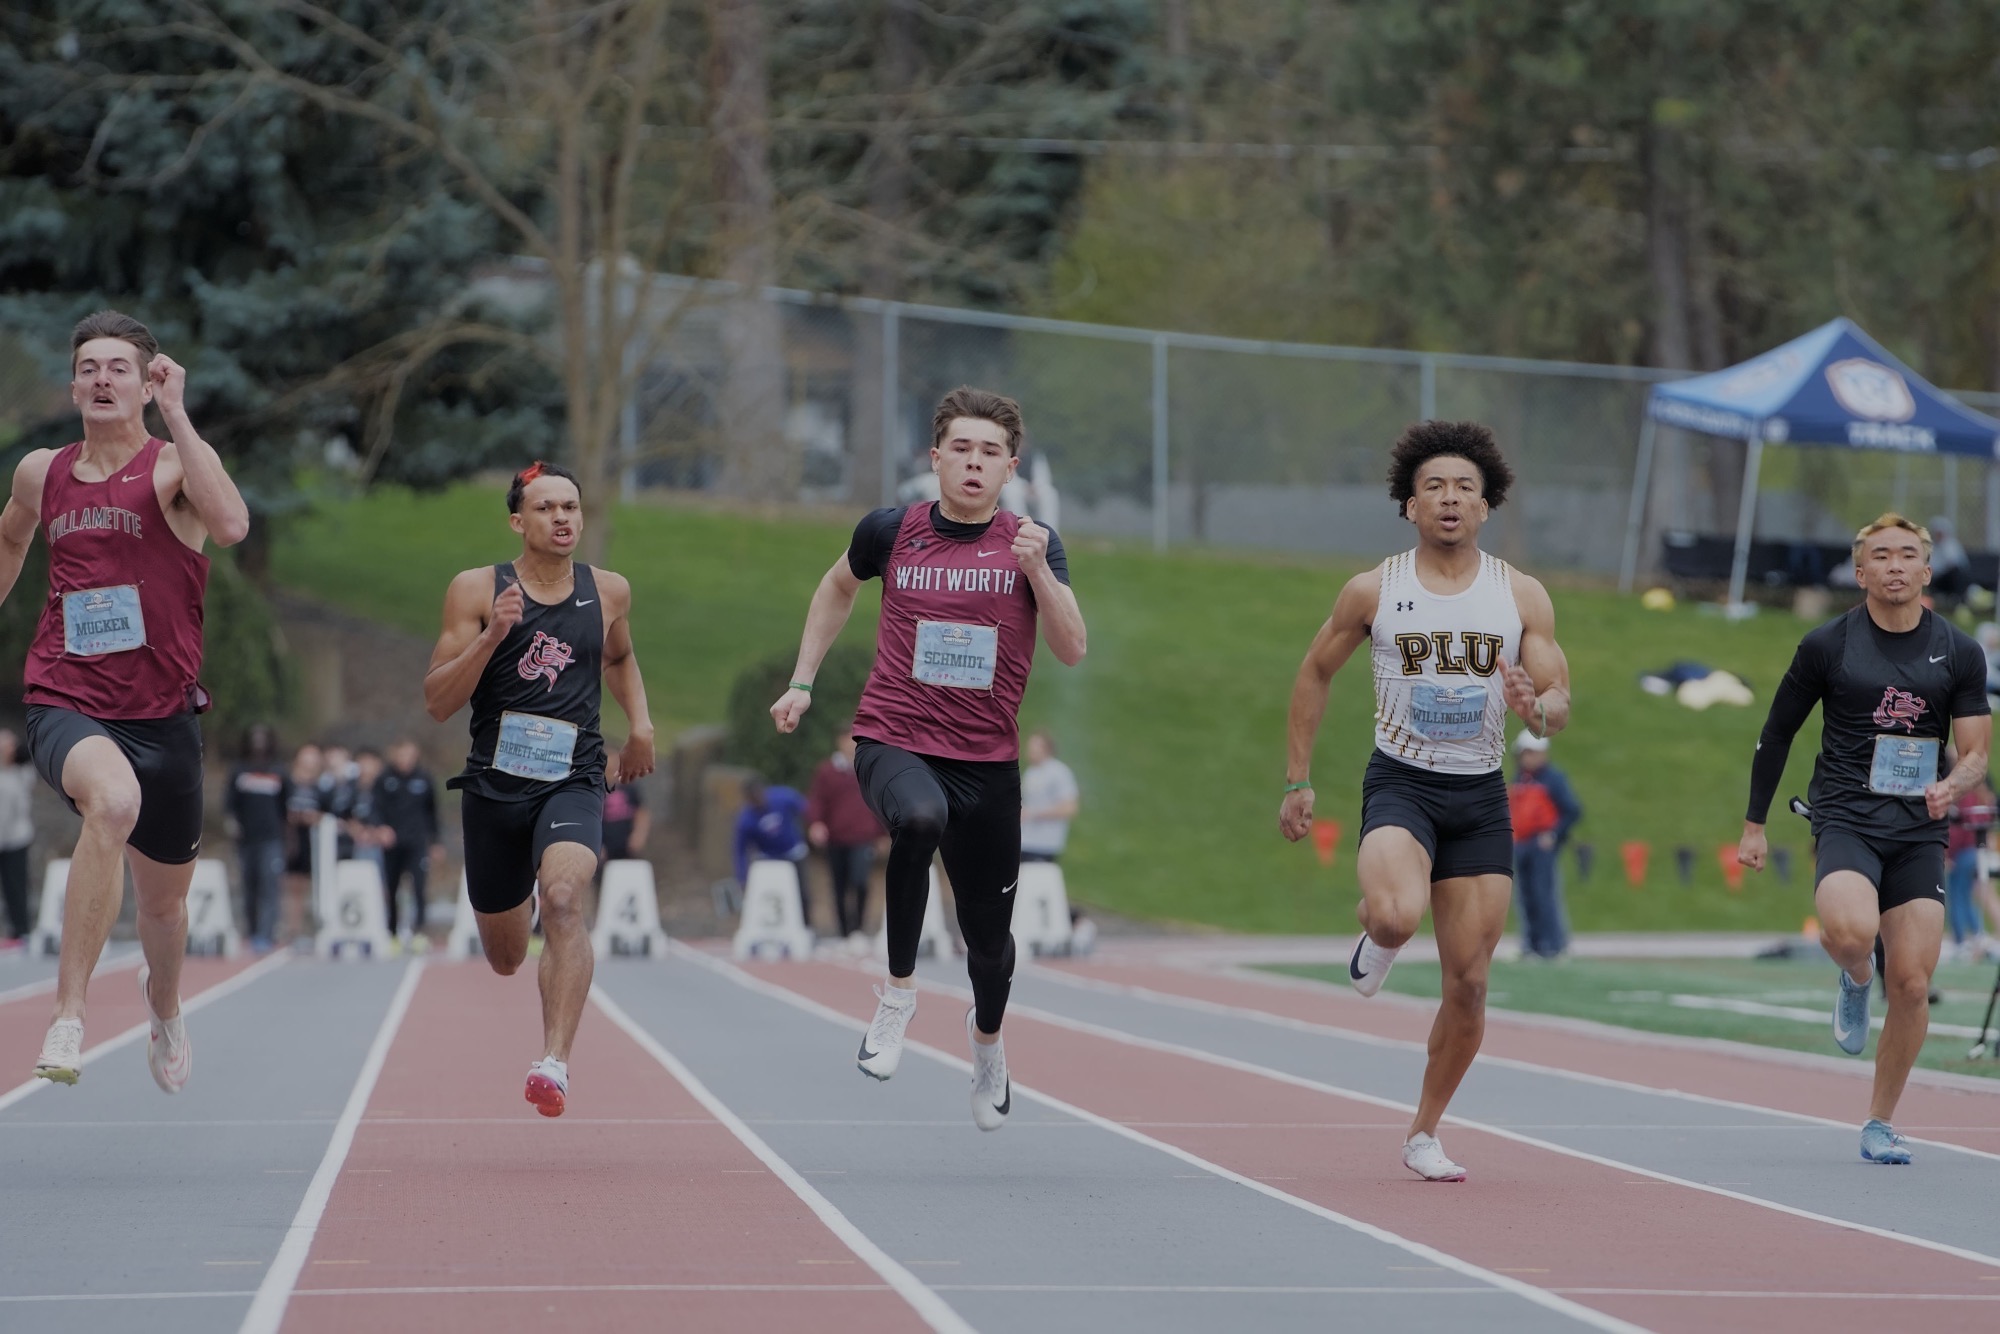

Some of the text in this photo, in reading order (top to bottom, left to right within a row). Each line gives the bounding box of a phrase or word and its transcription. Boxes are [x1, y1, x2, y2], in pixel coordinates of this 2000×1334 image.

[1848, 421, 1937, 451] TRACK
[48, 506, 143, 546] WILLAMETTE
[896, 566, 1016, 594] WHITWORTH
[75, 617, 130, 637] MUCKEN
[924, 650, 985, 669] SCHMIDT
[1395, 631, 1503, 678] PLU
[1412, 708, 1484, 725] WILLINGHAM
[1892, 765, 1920, 779] SERA
[341, 894, 362, 928] 6
[618, 893, 638, 925] 4
[761, 890, 783, 927] 3
[1036, 898, 1049, 928] 1
